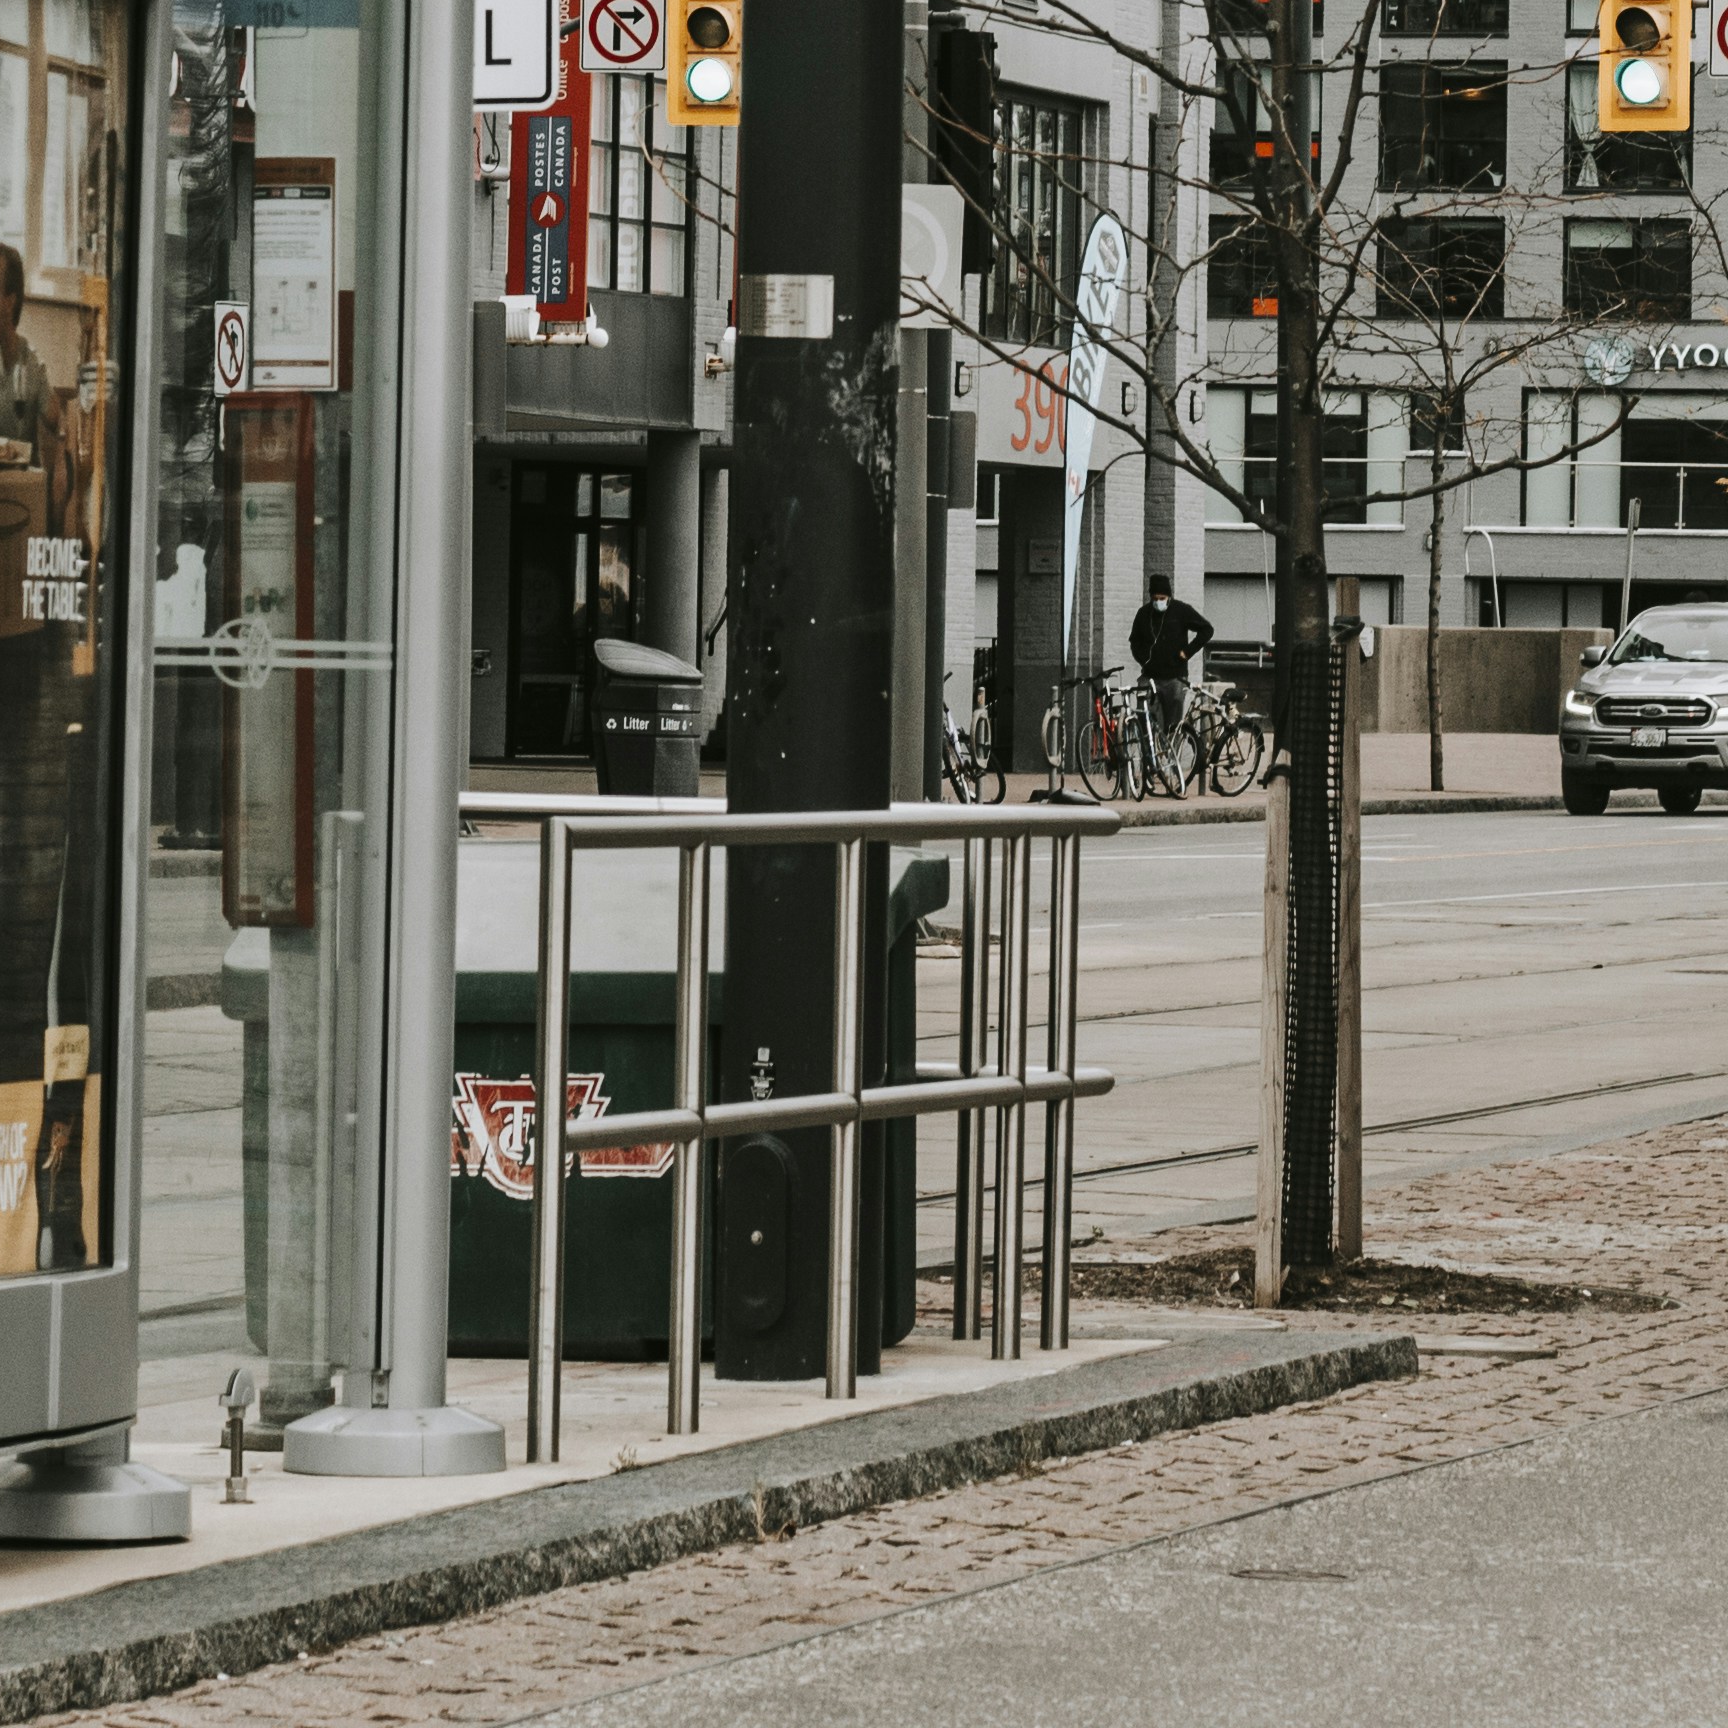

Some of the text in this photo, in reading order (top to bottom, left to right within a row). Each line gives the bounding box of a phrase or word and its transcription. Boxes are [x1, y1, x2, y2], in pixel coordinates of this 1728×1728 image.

[534, 132, 546, 188] POSTES
[553, 125, 567, 188] CANADA
[531, 232, 543, 295] CANADA
[551, 257, 562, 296] POST
[22, 579, 87, 621] THE TABLE
[623, 715, 651, 730] Litter
[660, 717, 681, 731] Litter
[10, 1122, 29, 1161] OF
